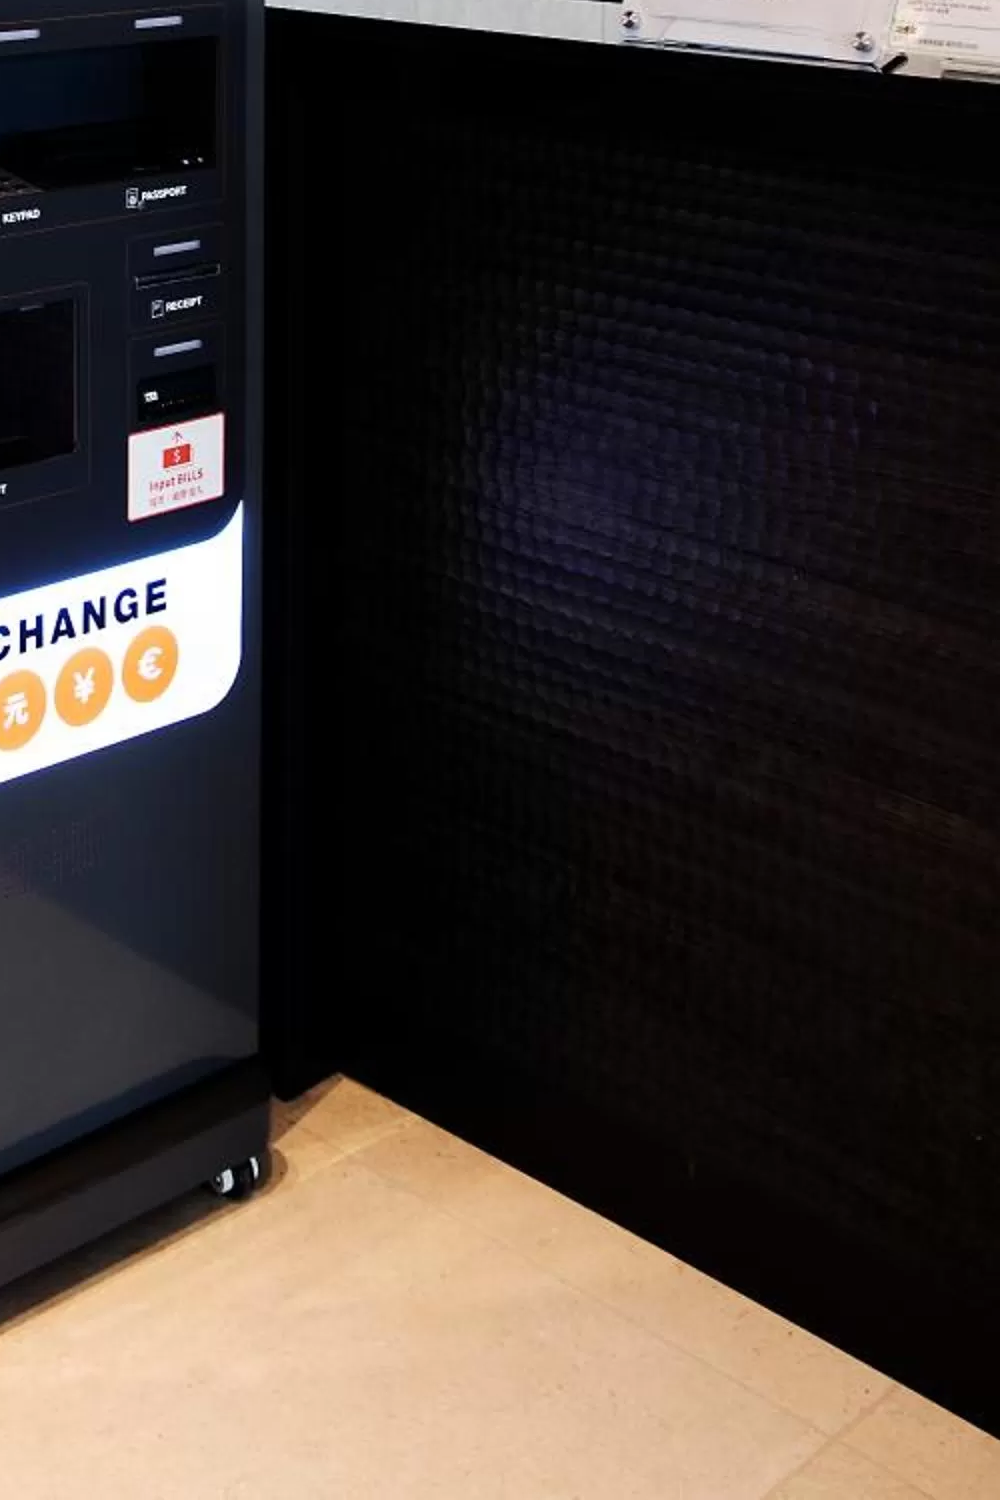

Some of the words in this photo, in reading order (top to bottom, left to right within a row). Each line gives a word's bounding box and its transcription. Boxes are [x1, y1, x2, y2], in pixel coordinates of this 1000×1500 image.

[140, 184, 188, 202] PASSPORT
[1, 207, 41, 225] KEYPAD
[165, 295, 204, 313] RECEIPT
